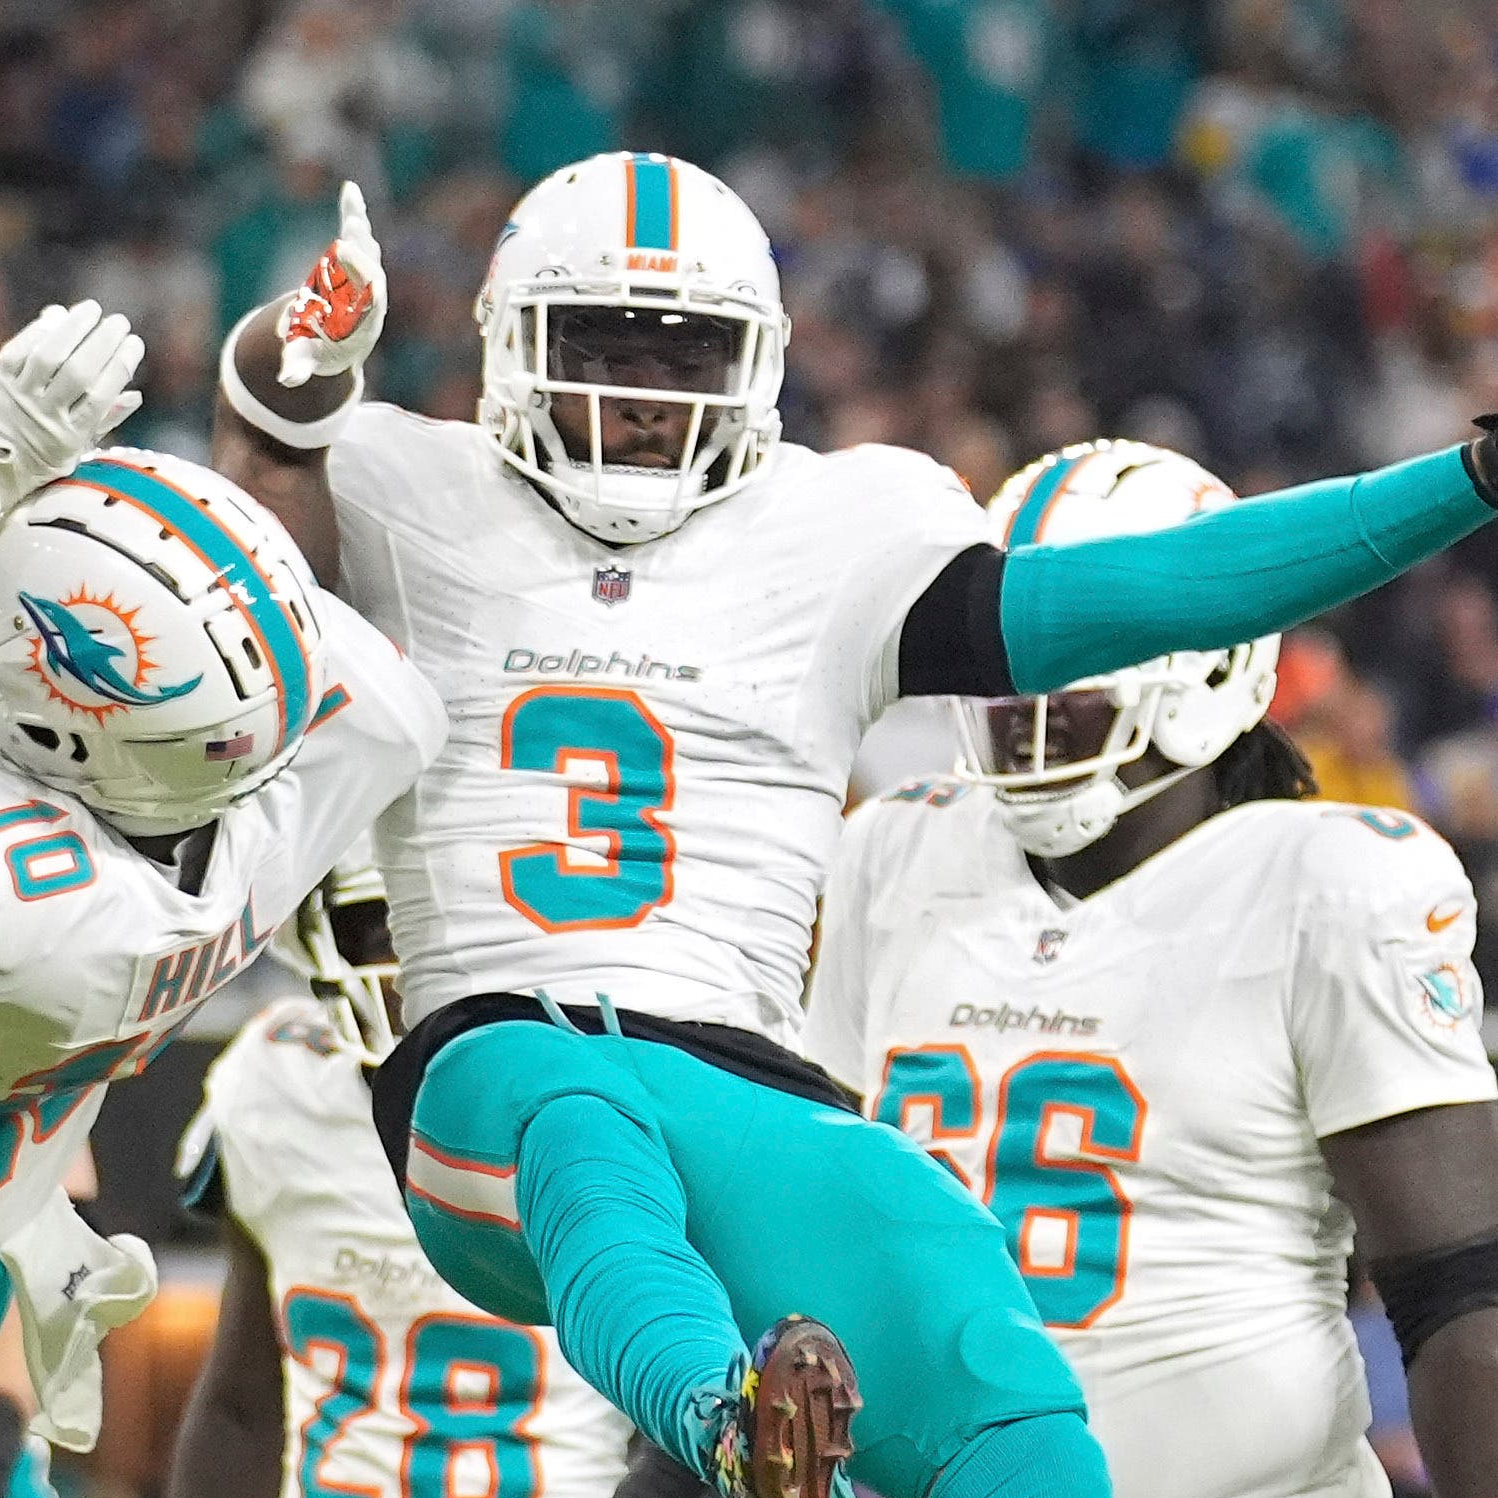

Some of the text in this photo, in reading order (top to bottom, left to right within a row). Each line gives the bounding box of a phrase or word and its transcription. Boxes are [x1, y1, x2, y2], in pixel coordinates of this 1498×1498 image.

[503, 648, 703, 683] Dolphins
[500, 685, 675, 933] 3
[136, 883, 275, 1023] HILL
[948, 1001, 1104, 1037] Dolphins
